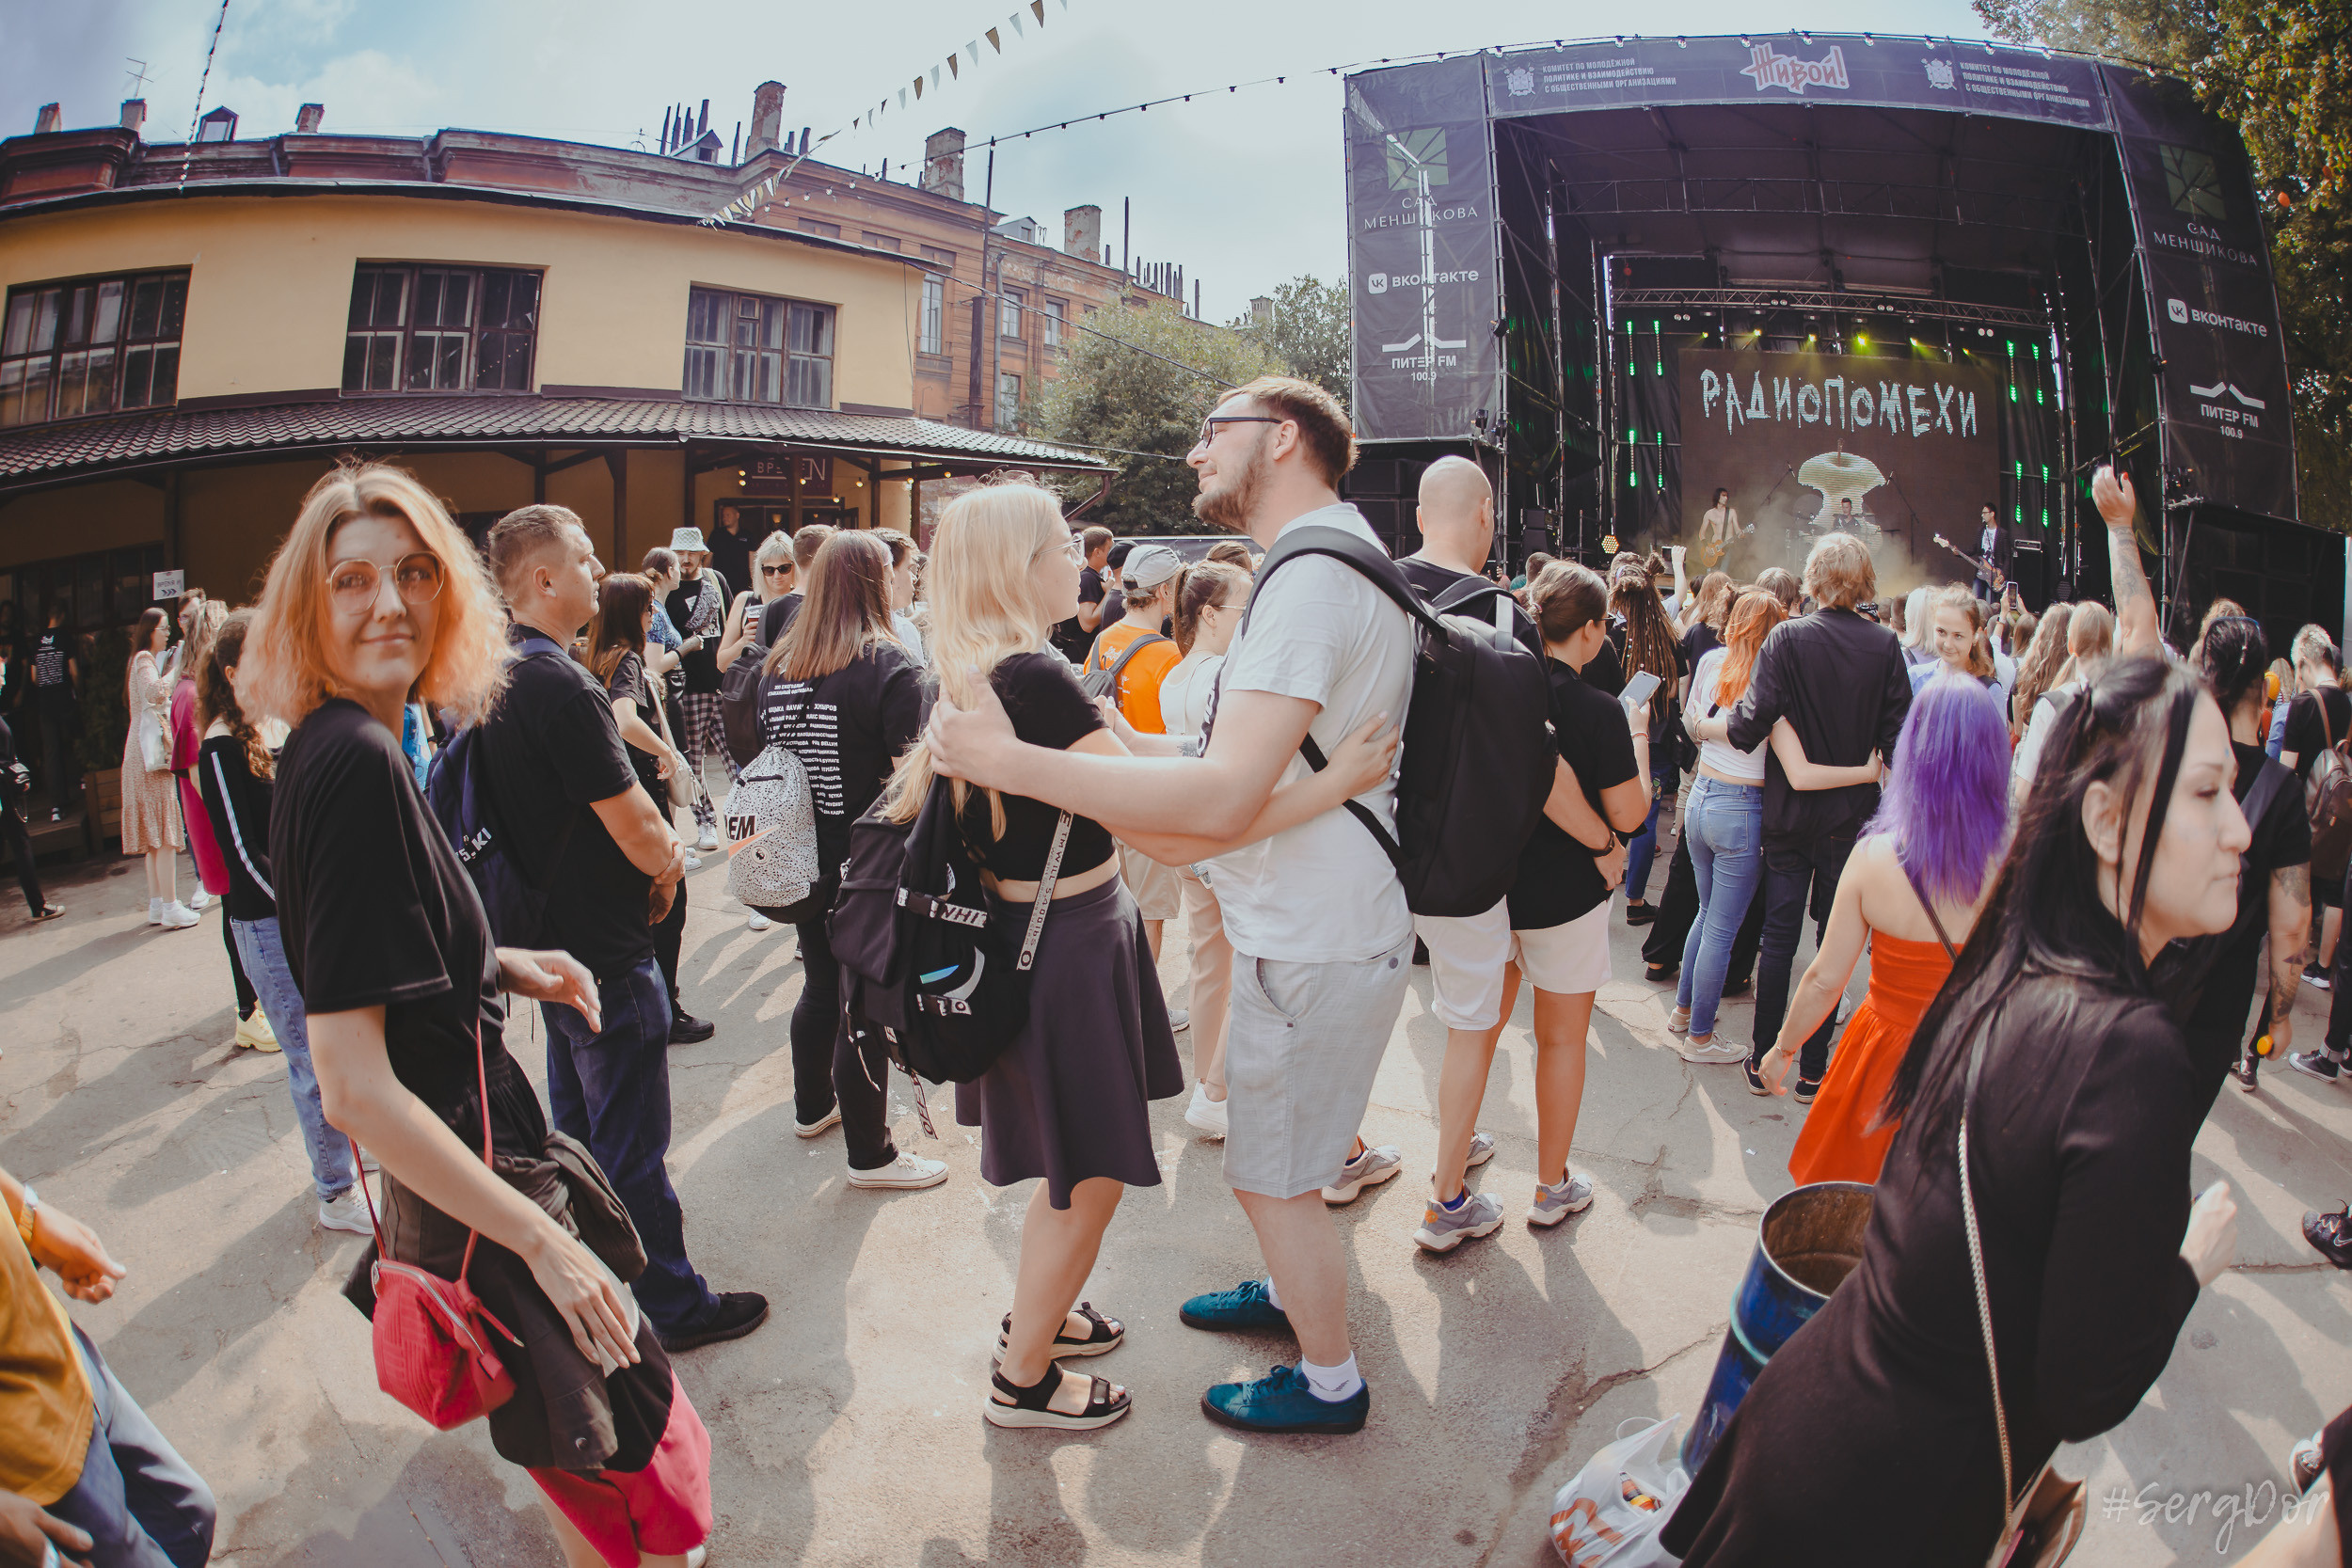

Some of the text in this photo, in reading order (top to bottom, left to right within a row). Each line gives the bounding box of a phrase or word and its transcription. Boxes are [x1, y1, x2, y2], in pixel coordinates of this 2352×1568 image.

[1542, 57, 1635, 73] КОМИТЕТ ПО МОЛОДЁЖНОЙ
[1960, 61, 2050, 80] КОМИТЕТ ПО МОЛОДЁЖНОЙ
[1543, 67, 1654, 83] ПОЛИТИКЕ И ВЗАИМОДЕЙСТВИЮ
[1963, 71, 2069, 94] ПОЛИТИКЕ И ВЗАИМОДЕЙСТВИЮ
[1544, 77, 1677, 93] С ОБЩЕСТВЕННЫМИ ОРГАНИЗАЦИЯМИ
[1965, 83, 2090, 107] С ОБЩЕСТВЕННЫМИ ОРГАНИЗАЦИЯМИ
[2187, 222, 2220, 242] САД
[2153, 231, 2258, 266] МЕНШИКОВА
[1391, 356, 1456, 370] ПИТЕР FM
[1411, 372, 1437, 381] 100.9
[1700, 369, 1977, 437] РАДИОПОМЕХИ
[2201, 404, 2259, 428] ПИТЕР FM
[2220, 425, 2244, 439] 100.9
[724, 815, 755, 840] EM
